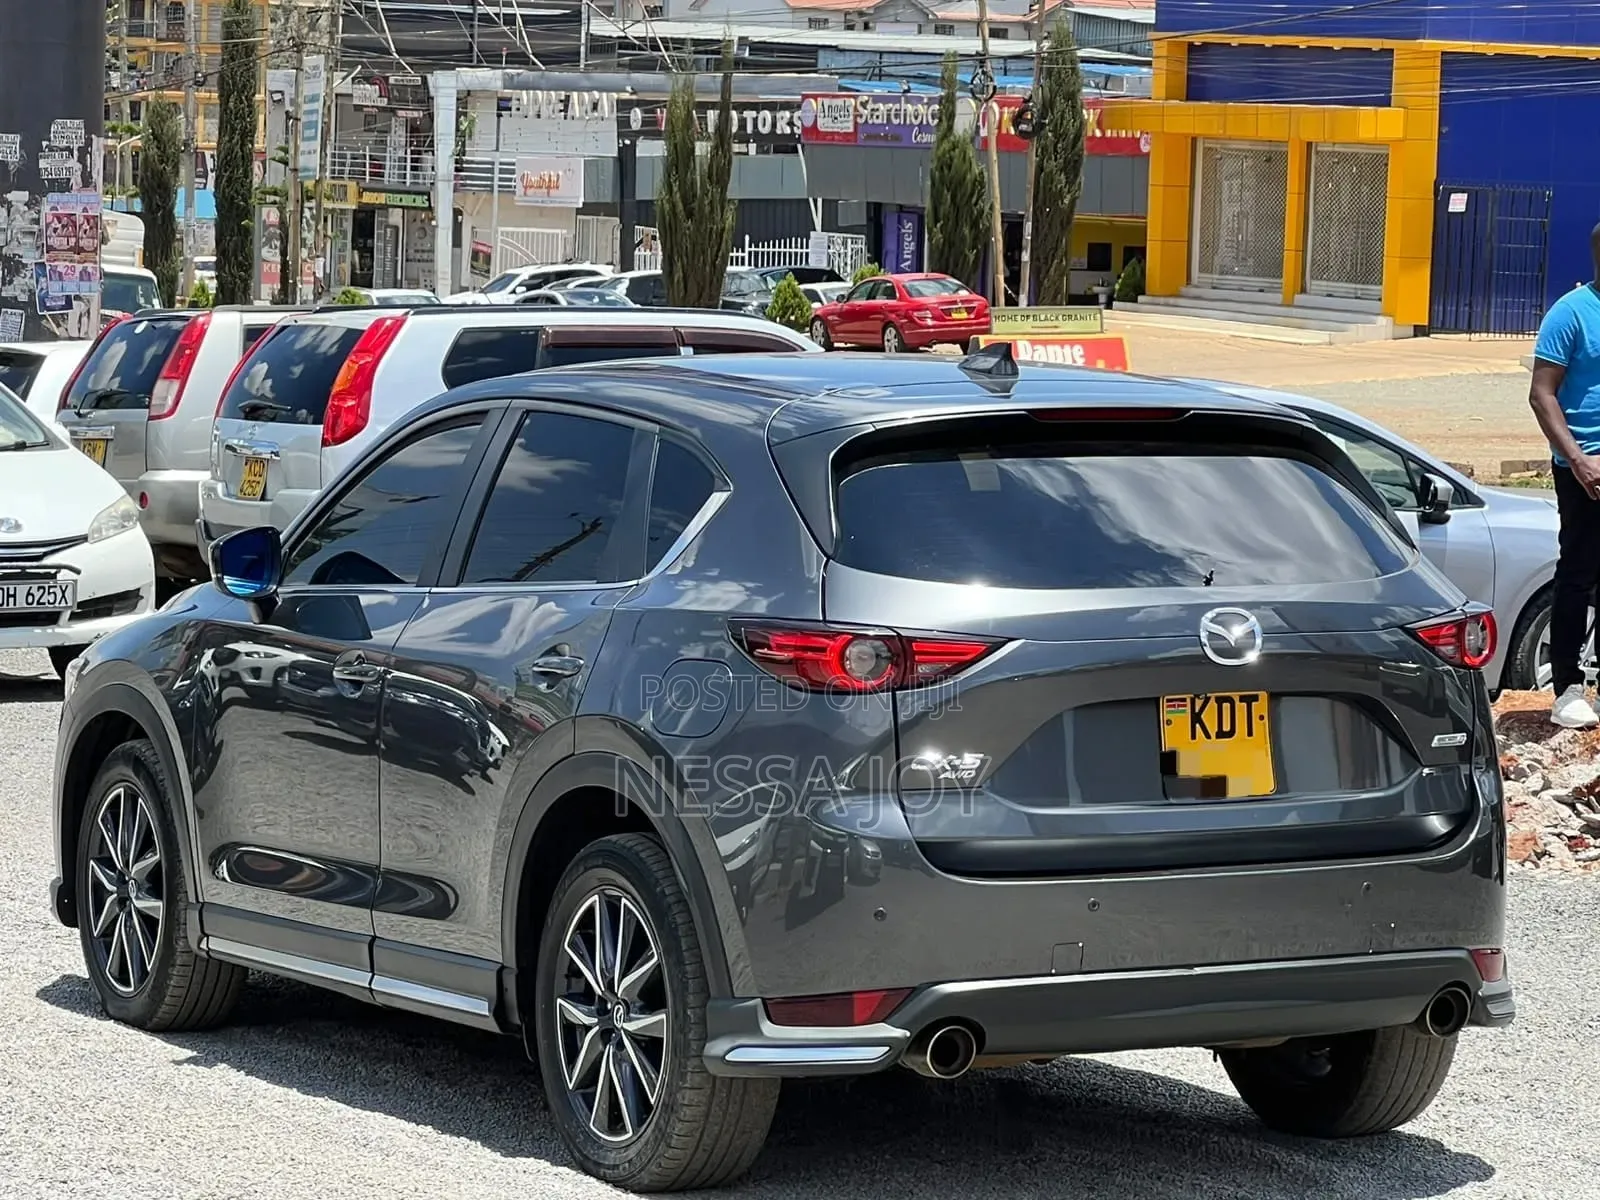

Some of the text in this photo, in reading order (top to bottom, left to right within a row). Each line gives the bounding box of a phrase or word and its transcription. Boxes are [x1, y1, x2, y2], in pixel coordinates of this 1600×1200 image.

[819, 101, 850, 123] Angels
[857, 96, 940, 126] Starchoic
[63, 265, 76, 276] 29
[995, 313, 1098, 323] HOME OF BLACK GRANITE
[25, 584, 69, 606] 625X
[1190, 695, 1260, 741] KDT
[911, 752, 984, 771] CX-5
[938, 769, 976, 779] AWD
